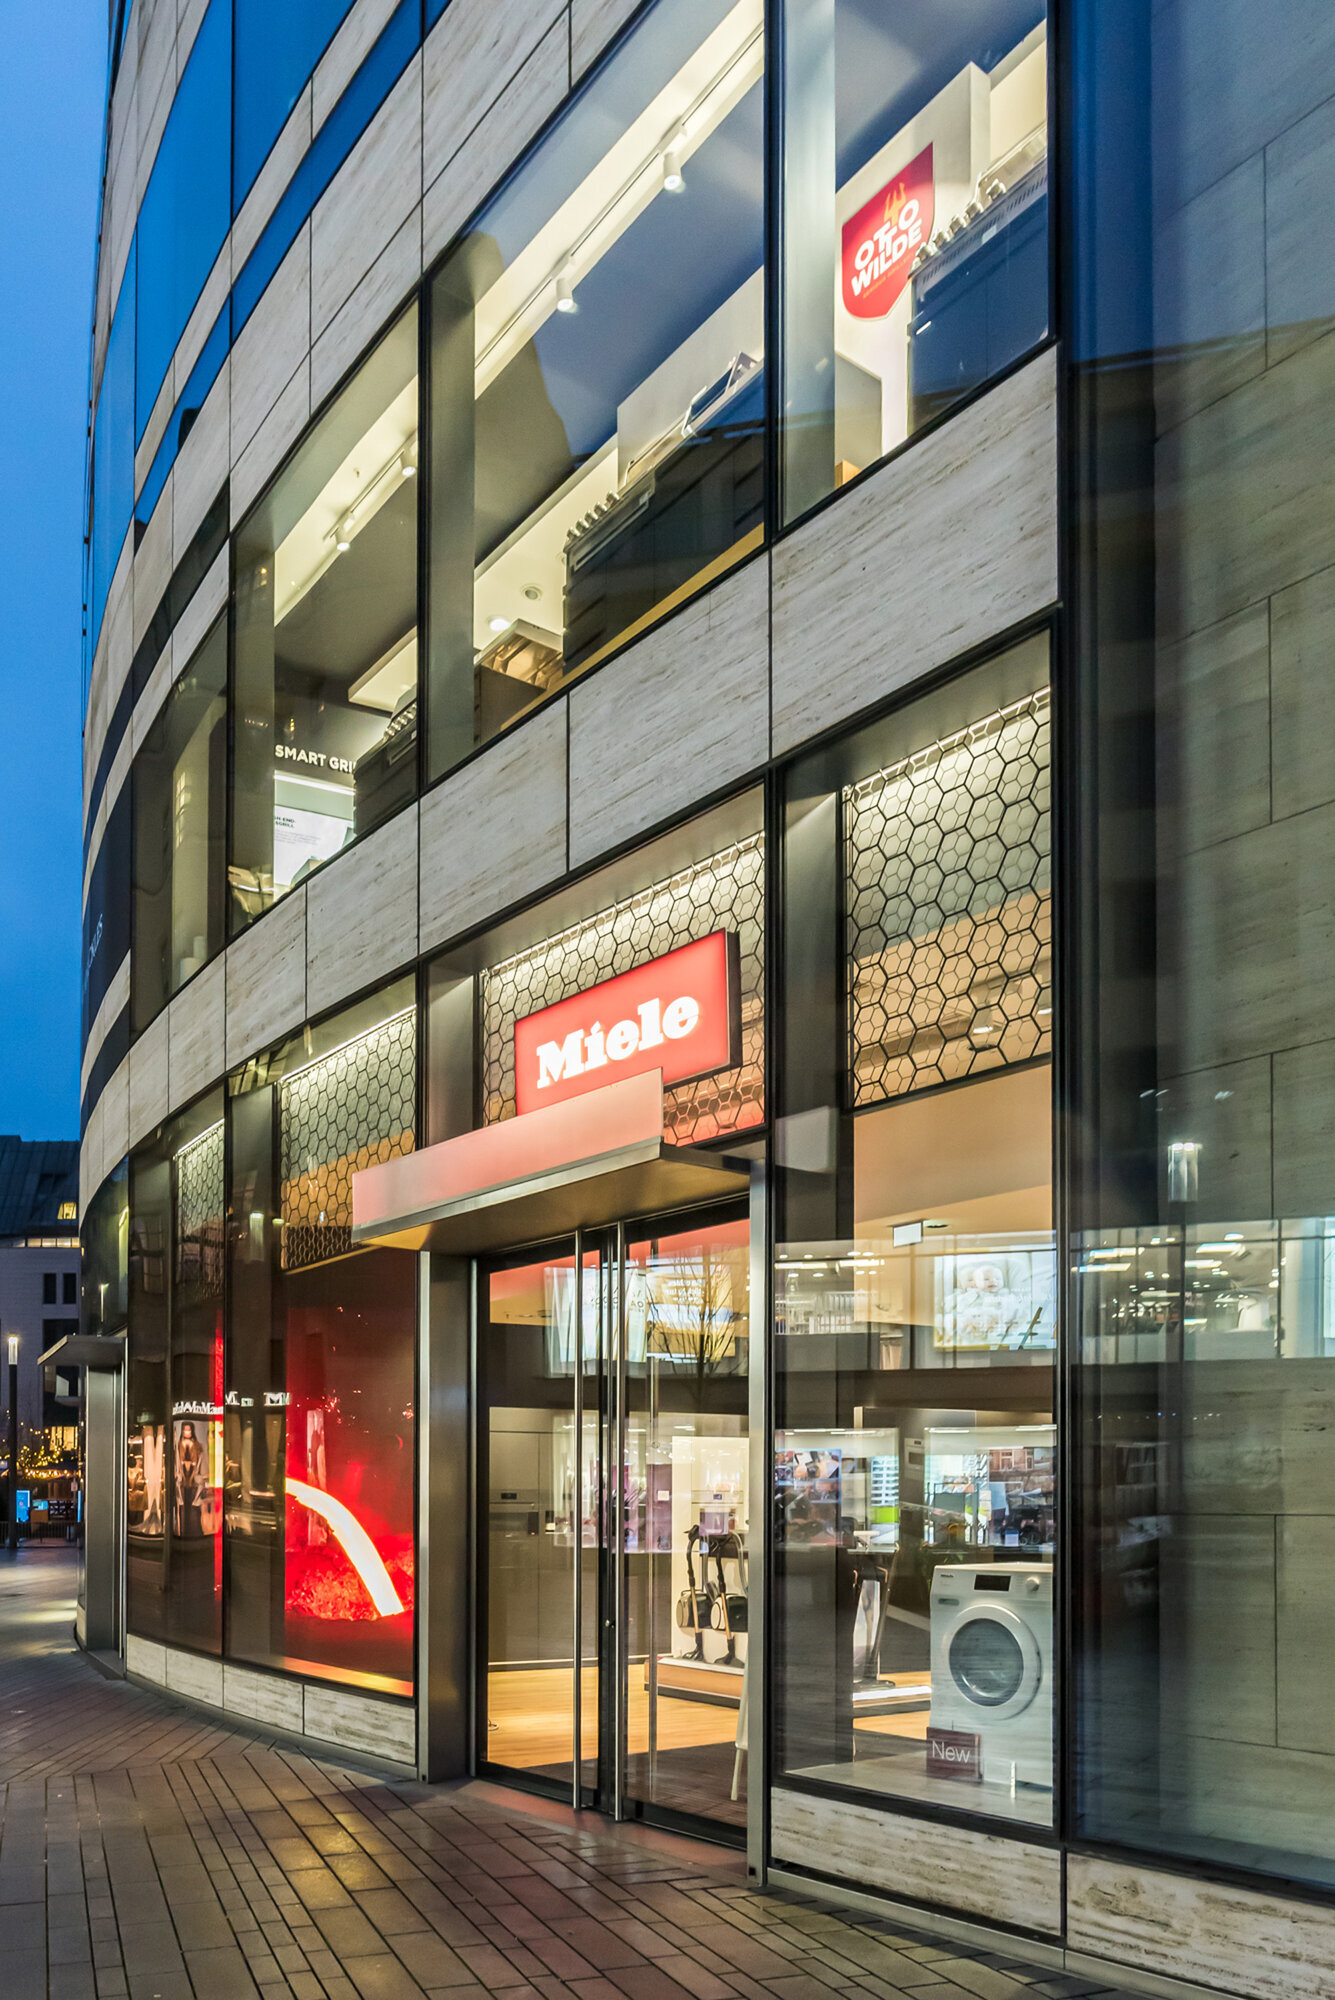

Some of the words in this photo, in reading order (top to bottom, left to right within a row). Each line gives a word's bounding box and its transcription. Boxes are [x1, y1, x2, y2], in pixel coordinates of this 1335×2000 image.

[851, 218, 922, 296] WILDE
[854, 199, 919, 270] OTTO
[275, 744, 326, 766] SMART
[536, 996, 699, 1089] Miele
[932, 1740, 970, 1763] New
